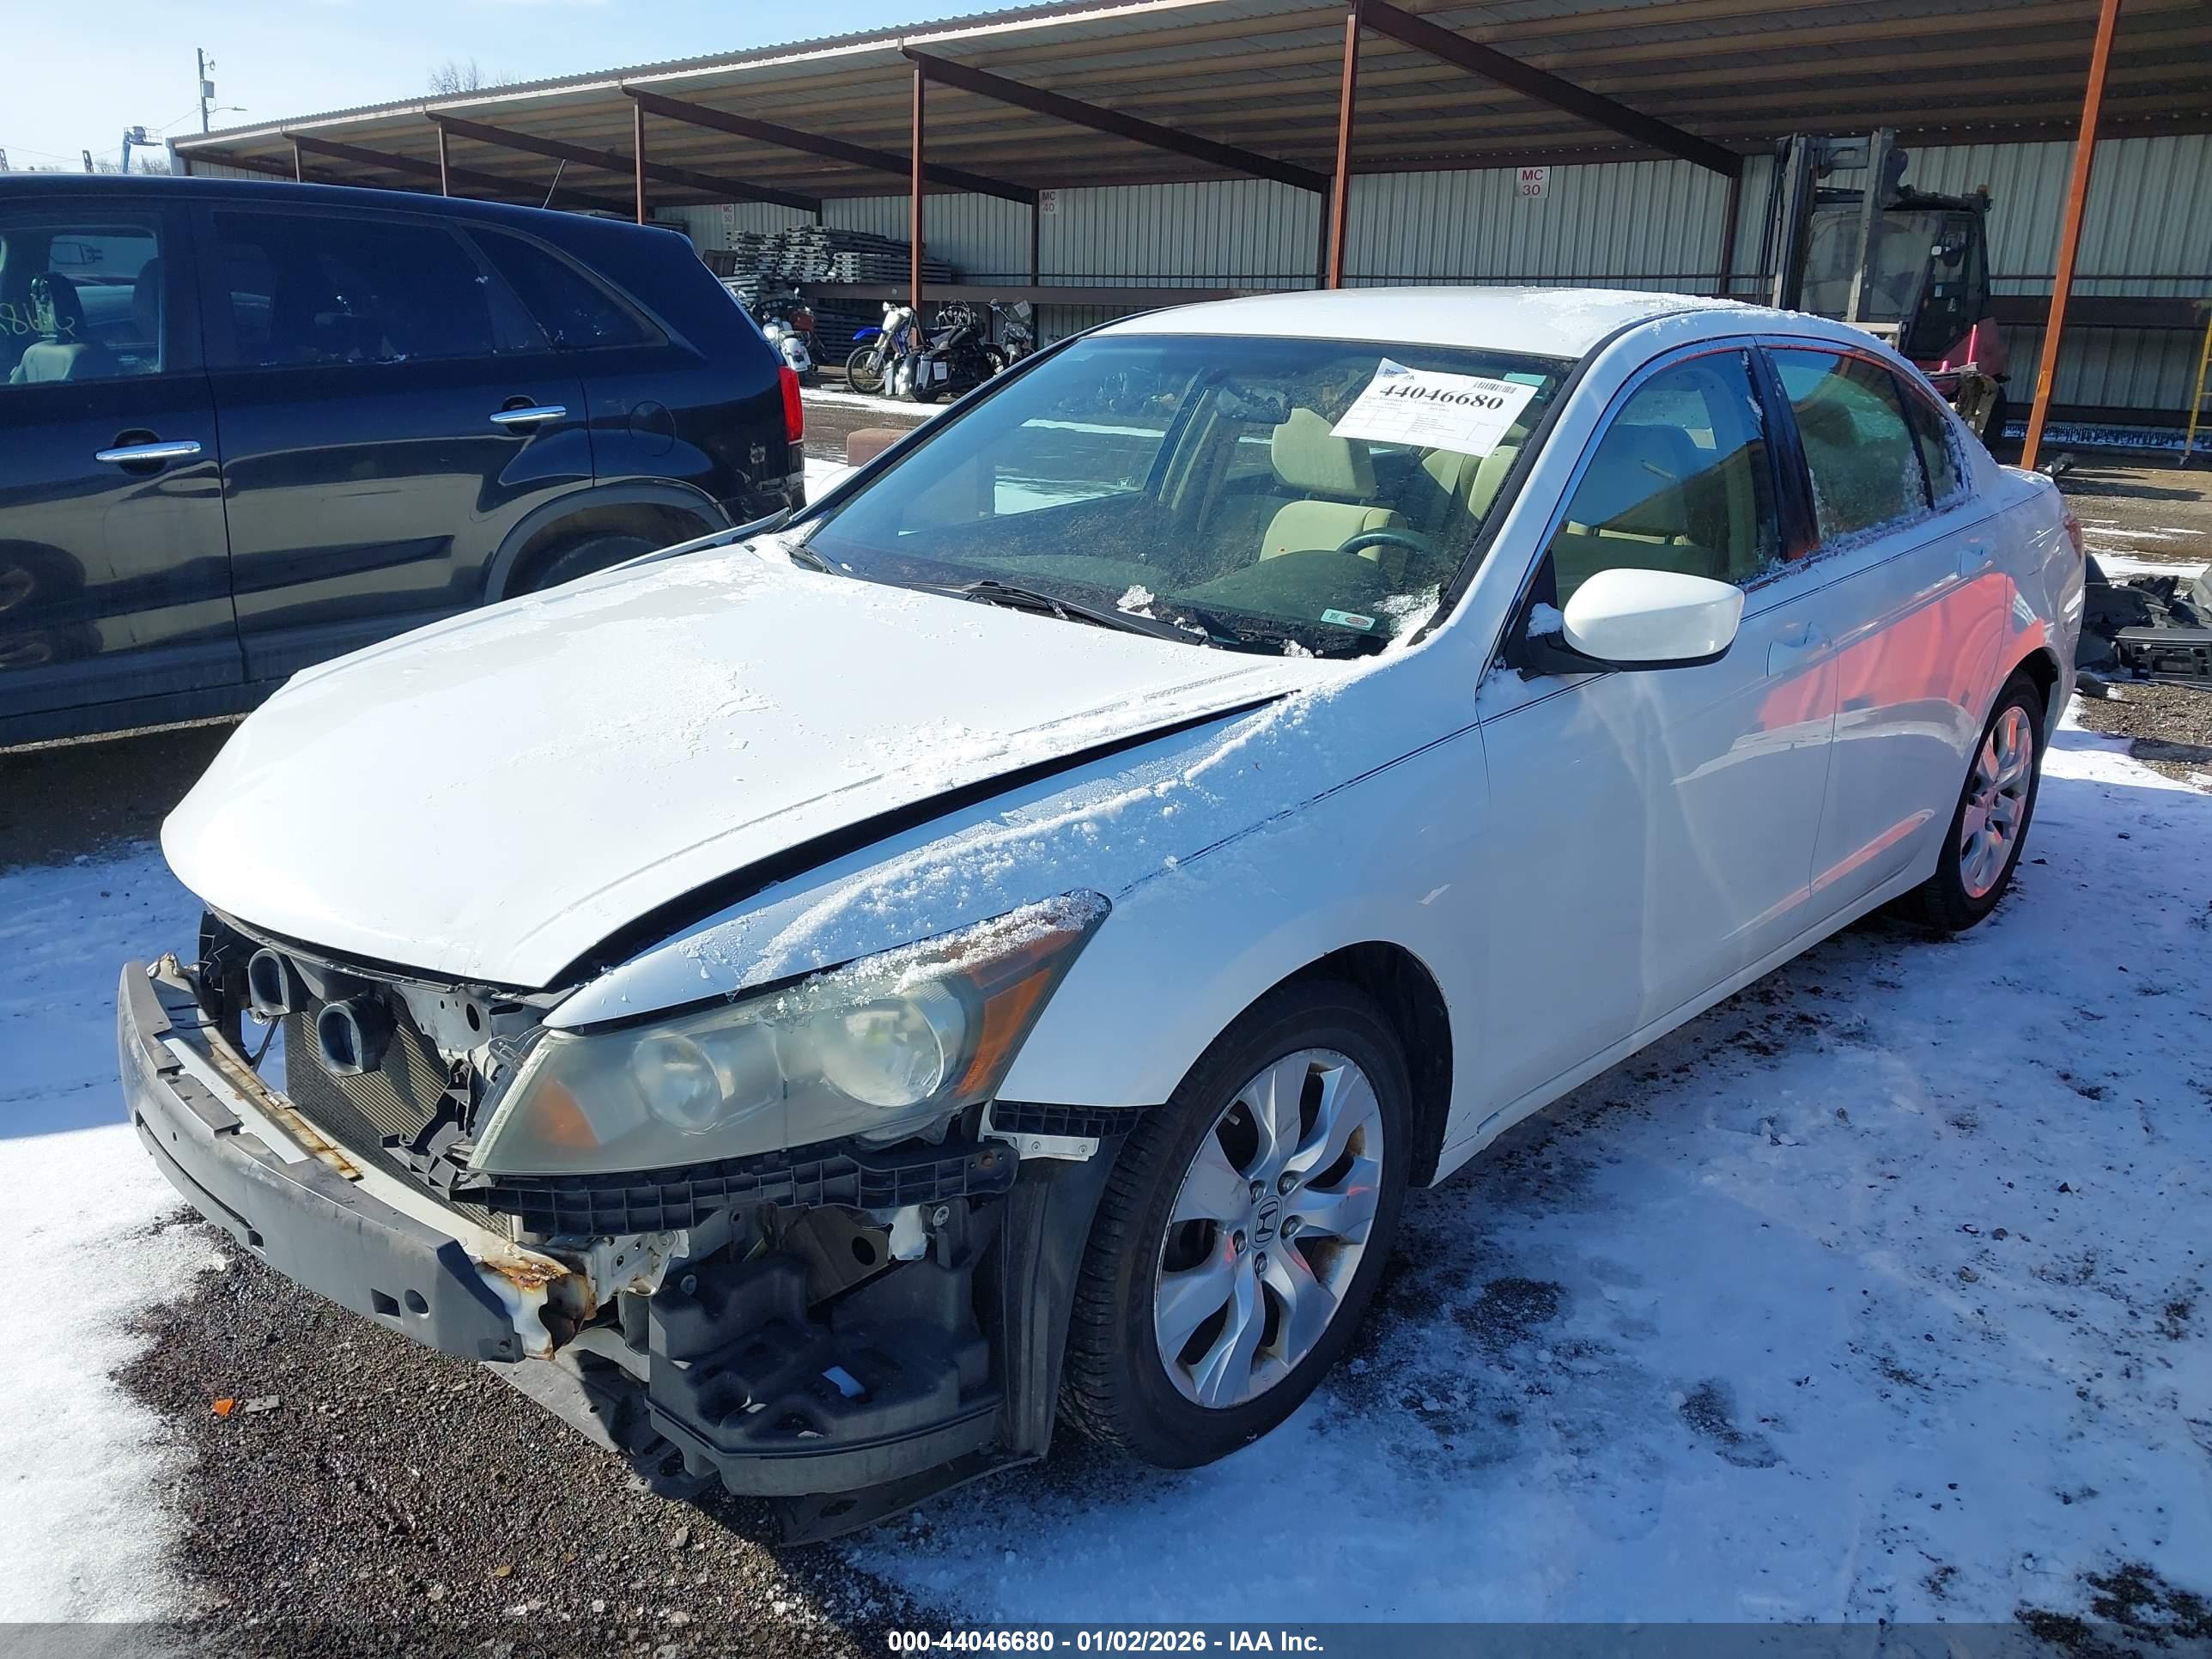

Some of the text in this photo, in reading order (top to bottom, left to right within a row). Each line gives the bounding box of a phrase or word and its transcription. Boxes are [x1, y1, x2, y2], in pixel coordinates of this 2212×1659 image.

[1522, 168, 1544, 181] MC
[1042, 191, 1056, 201] MC
[1522, 184, 1541, 197] 30
[1379, 384, 1504, 410] 44046680
